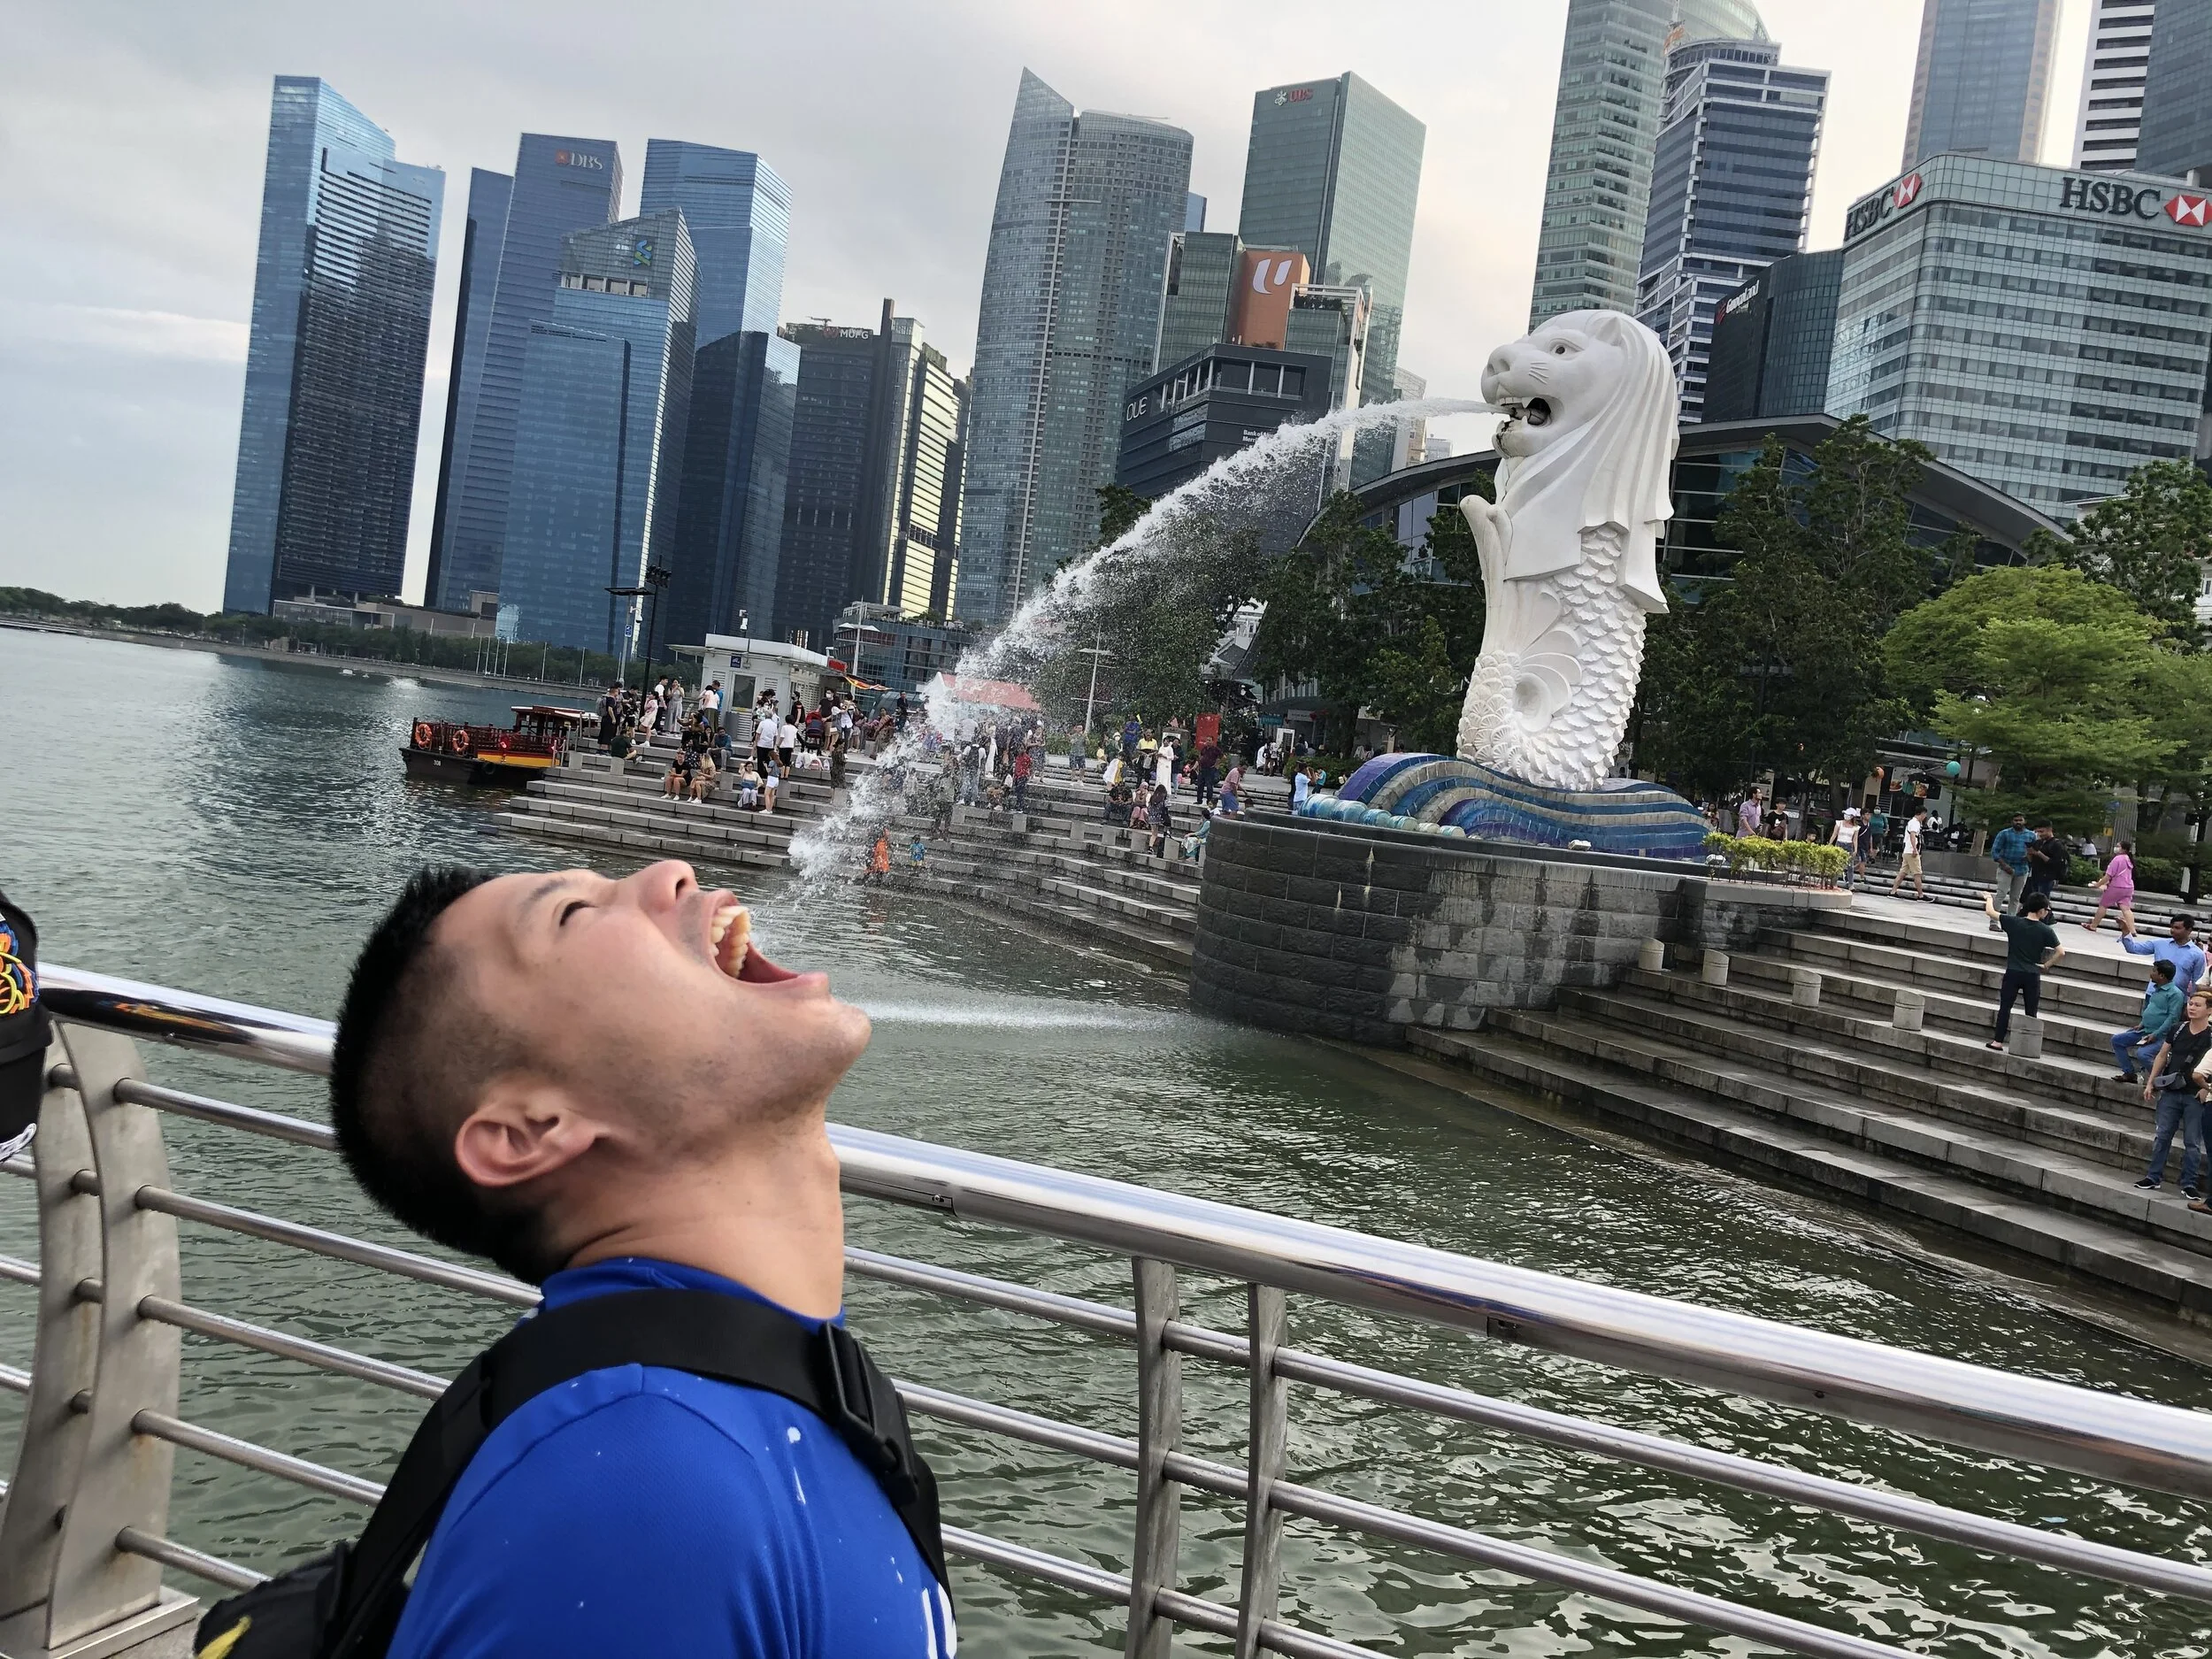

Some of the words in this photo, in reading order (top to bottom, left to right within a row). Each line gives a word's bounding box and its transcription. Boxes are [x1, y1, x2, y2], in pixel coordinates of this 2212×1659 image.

[571, 151, 603, 171] DBS
[1843, 185, 1895, 242] HSBC
[2060, 177, 2162, 220] HSBC
[1126, 396, 1148, 421] OUE
